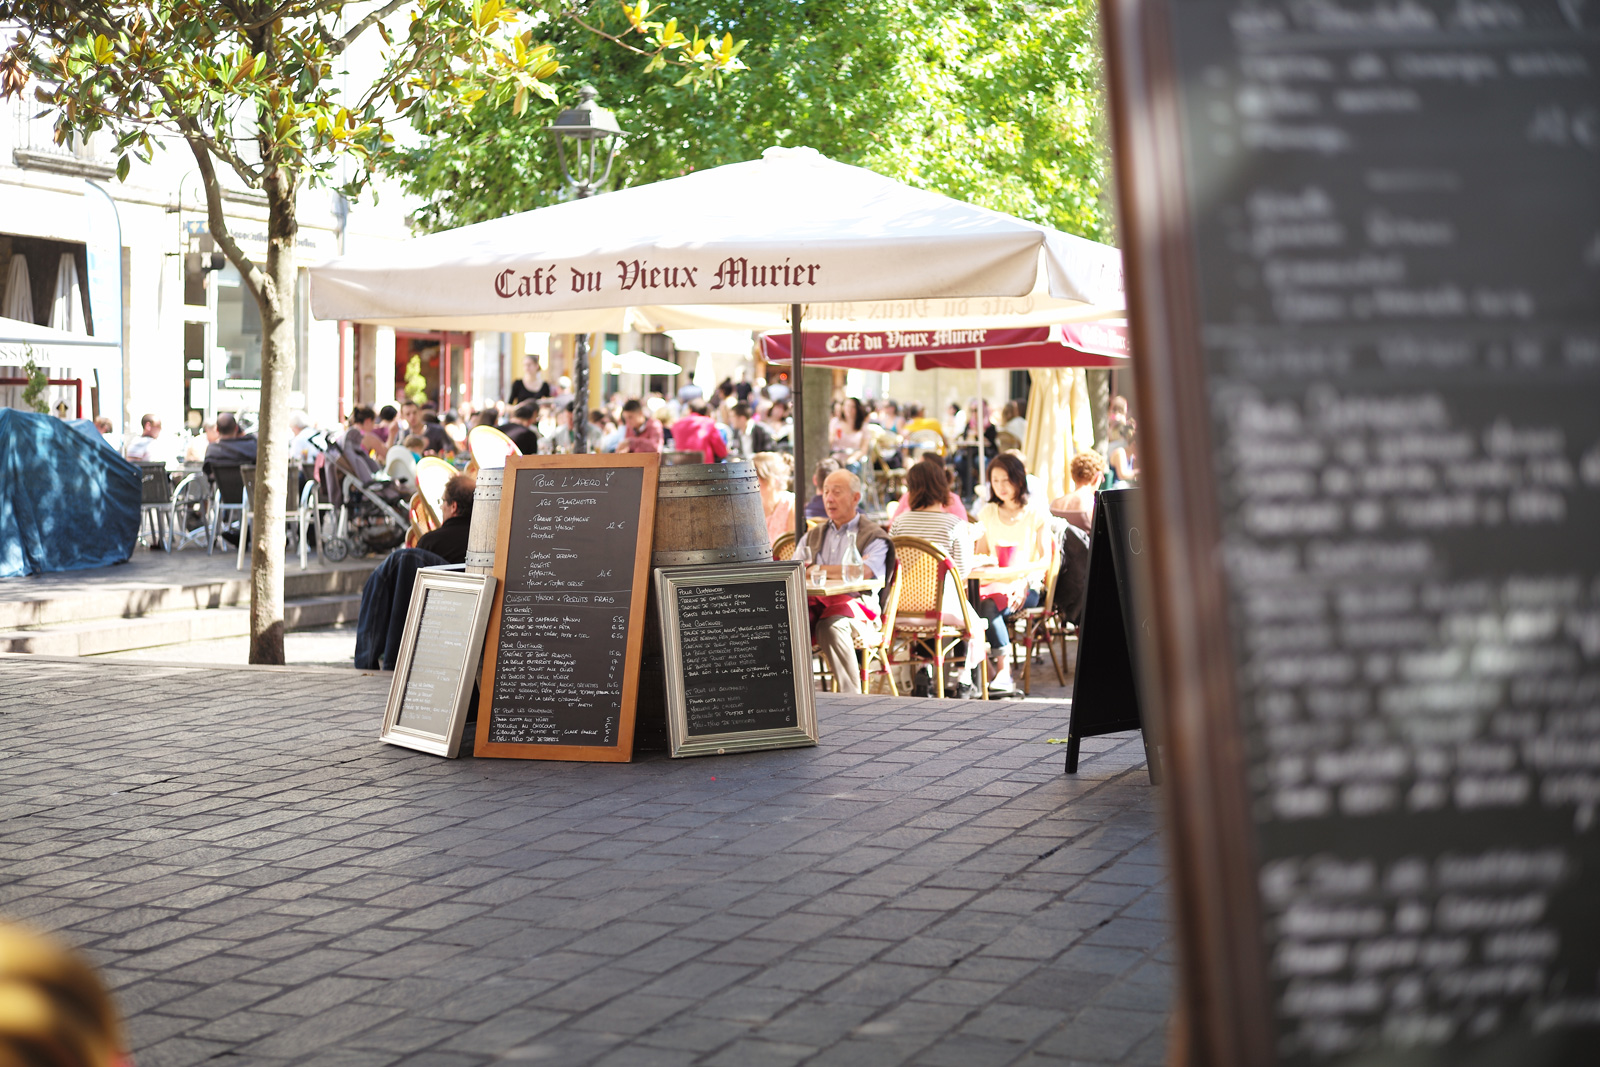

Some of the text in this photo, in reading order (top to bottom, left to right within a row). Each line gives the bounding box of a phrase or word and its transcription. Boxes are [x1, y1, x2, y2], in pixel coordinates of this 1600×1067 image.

[494, 256, 821, 299] Café du Vieux Murier
[825, 328, 987, 353] Café du Vieux Murier
